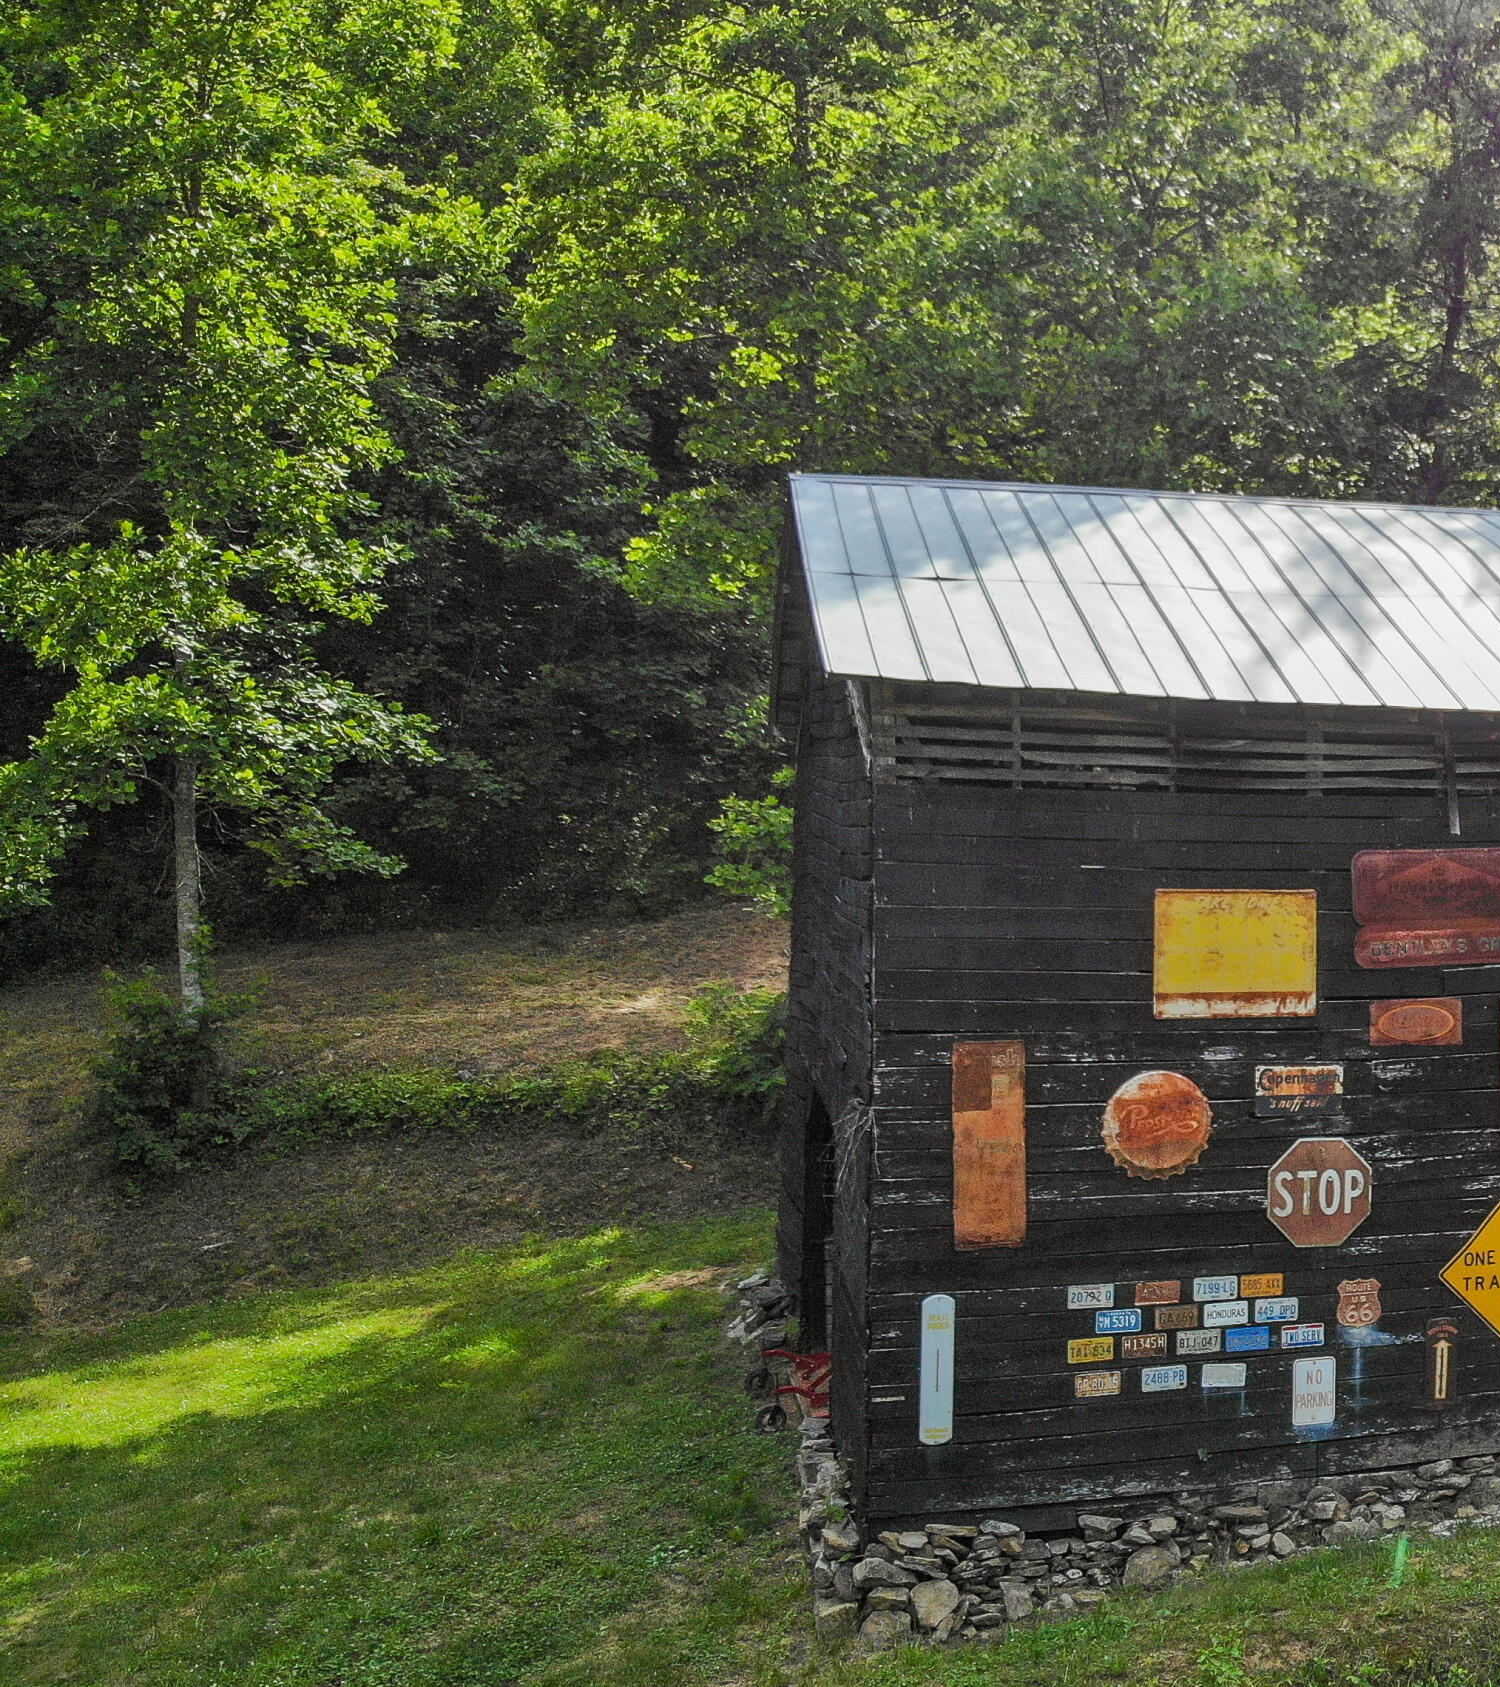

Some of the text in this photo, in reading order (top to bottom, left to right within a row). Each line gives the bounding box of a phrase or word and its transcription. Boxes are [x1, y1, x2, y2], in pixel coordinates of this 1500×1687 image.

[1273, 1169, 1365, 1217] STOP
[1463, 1250, 1496, 1267] ONE
[1346, 1281, 1372, 1293] ROUTE
[1351, 1295, 1367, 1303] US
[1207, 1308, 1246, 1320] HONDURAS
[1345, 1304, 1373, 1323] 66
[1306, 1368, 1323, 1386] NO
[1296, 1390, 1333, 1410] PARKING
